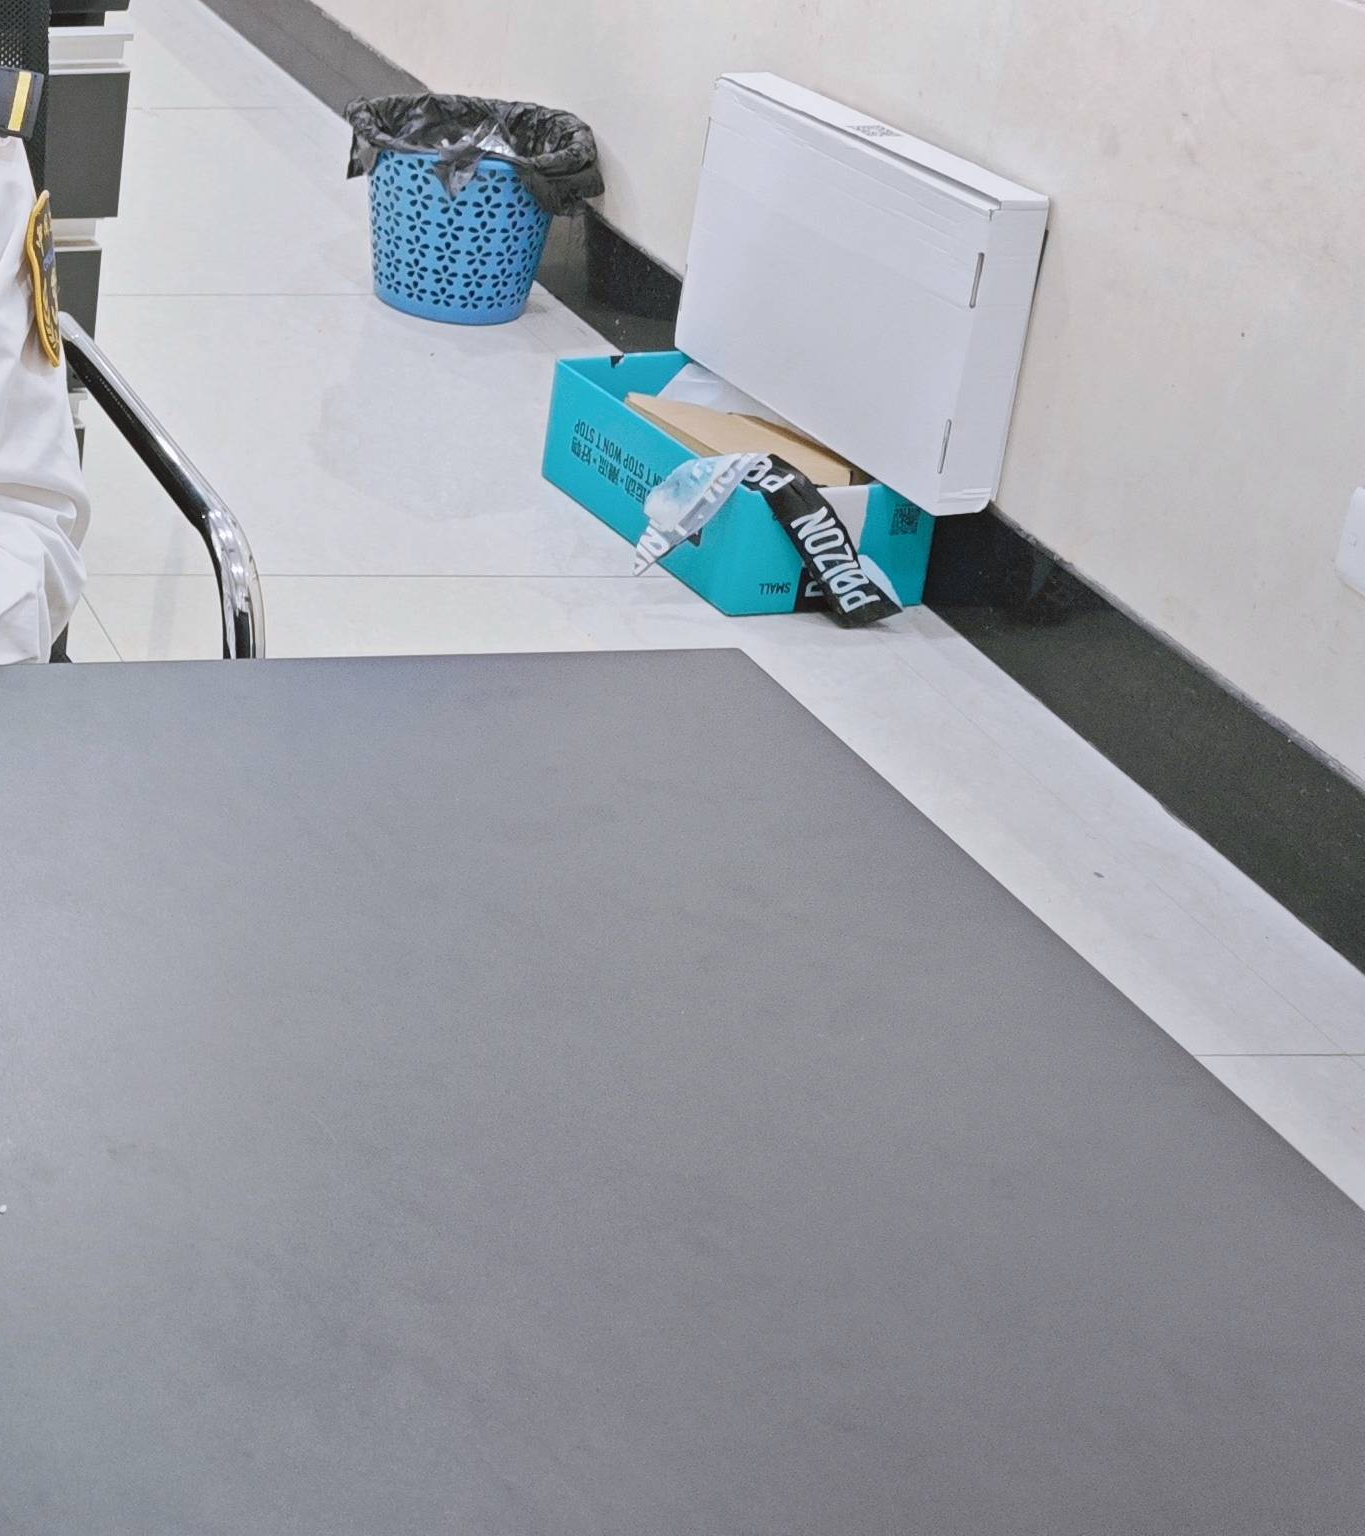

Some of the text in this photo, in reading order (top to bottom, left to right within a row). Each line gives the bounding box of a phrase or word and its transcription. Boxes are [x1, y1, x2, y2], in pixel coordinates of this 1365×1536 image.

[574, 419, 596, 444] STOP
[623, 453, 645, 478] STOP
[758, 582, 792, 595] SMALL
